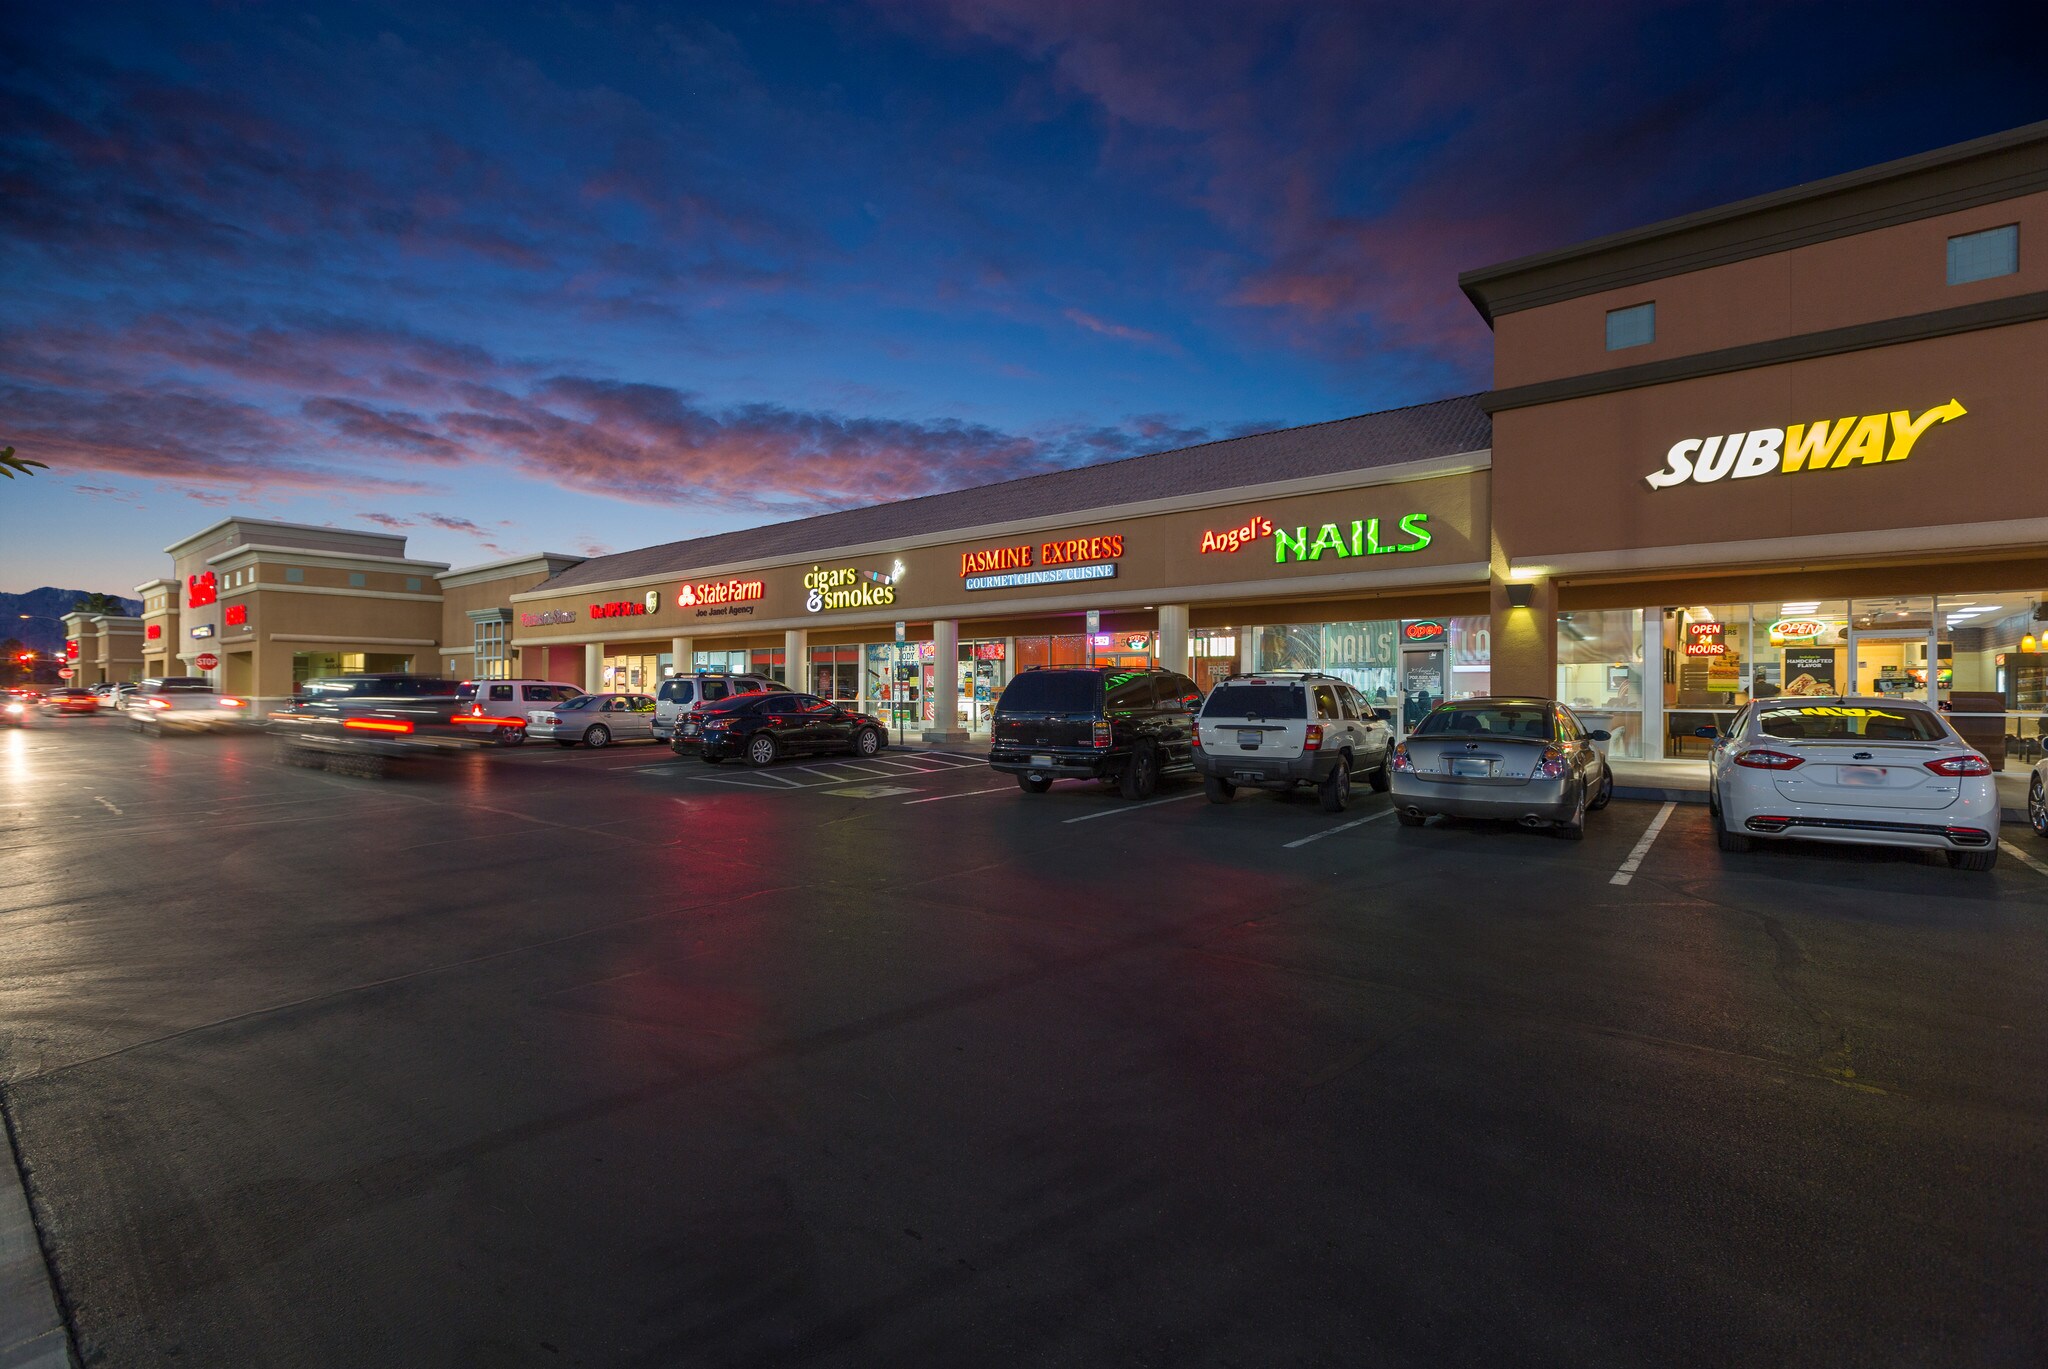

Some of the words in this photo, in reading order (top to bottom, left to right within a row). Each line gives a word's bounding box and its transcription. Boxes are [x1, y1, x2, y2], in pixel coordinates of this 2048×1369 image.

[1645, 398, 1967, 491] SUBWAY
[1201, 516, 1272, 553] Angel's
[1273, 513, 1432, 563] NAILS
[960, 545, 1032, 577] JASMINE
[1041, 535, 1124, 564] EXPRESS
[804, 565, 856, 595] cigars
[966, 575, 1015, 589] GOURMET
[1017, 570, 1063, 584] CHINESE
[1066, 564, 1113, 579] CUISINE
[806, 588, 823, 612] &
[824, 582, 895, 610] smokes
[604, 602, 621, 617] UPS
[621, 601, 645, 616] Store
[696, 609, 707, 617] Joe
[709, 607, 727, 616] Janet
[728, 605, 754, 615] Agency
[1406, 624, 1443, 637] Open
[1692, 624, 1721, 634] OPEN
[1778, 622, 1819, 634] OPEN
[1699, 635, 1713, 644] 24
[1329, 633, 1391, 663] NAILS
[1688, 644, 1725, 654] HOURS
[197, 658, 217, 666] STOP
[1207, 665, 1230, 675] FREE
